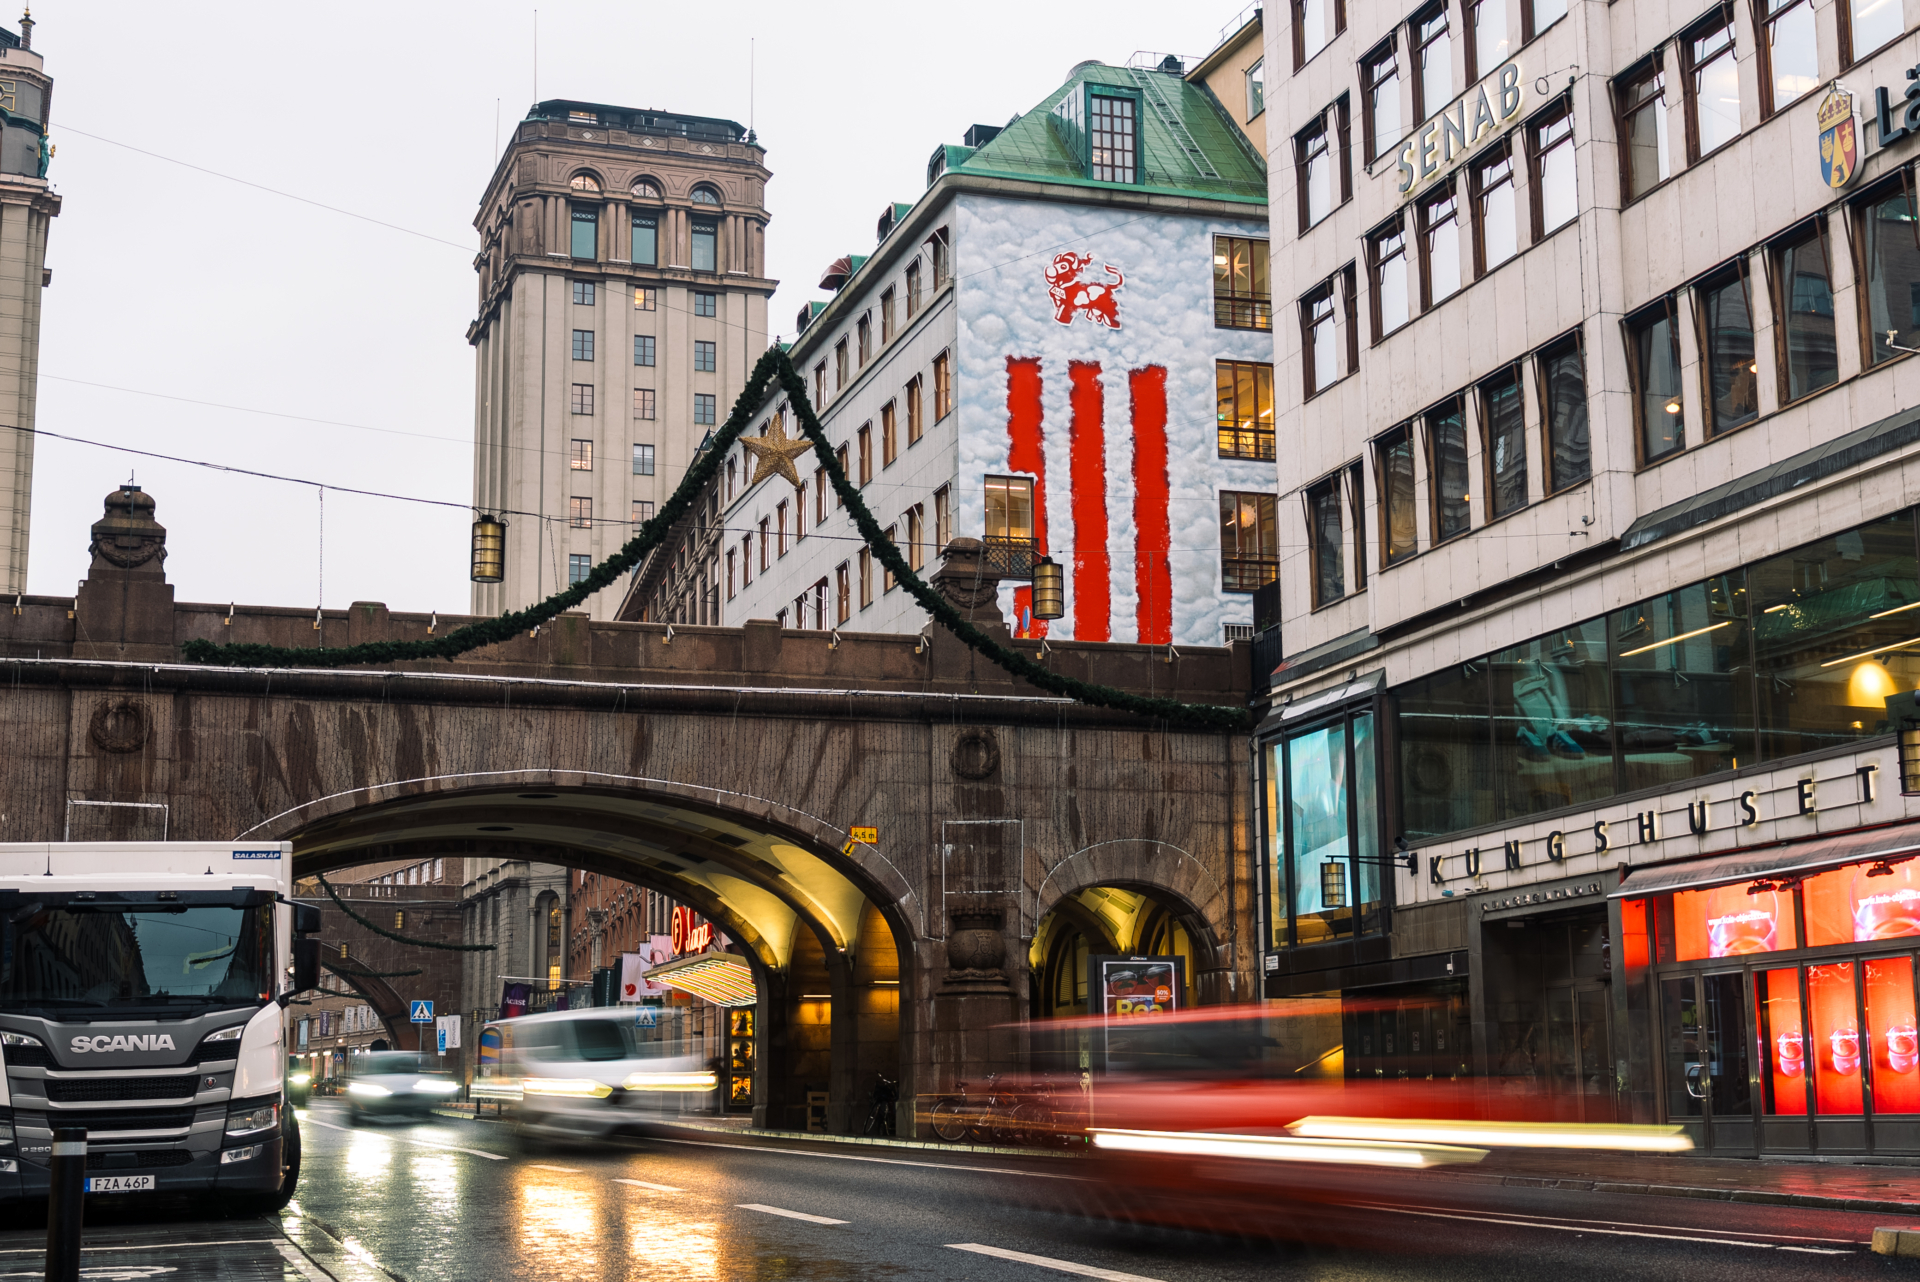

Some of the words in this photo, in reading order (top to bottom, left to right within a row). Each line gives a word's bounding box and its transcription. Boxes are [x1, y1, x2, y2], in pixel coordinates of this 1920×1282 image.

[1398, 63, 1521, 193] SENAB
[1052, 288, 1064, 297] Arla
[1430, 765, 1878, 885] KUNGSHUSET
[853, 831, 866, 839] 4,5
[686, 907, 711, 954] Saga
[504, 997, 526, 1006] Acast
[1116, 999, 1164, 1021] Rea
[70, 1034, 176, 1053] SCANIA
[95, 1178, 120, 1190] FZA
[123, 1177, 150, 1189] 46P
